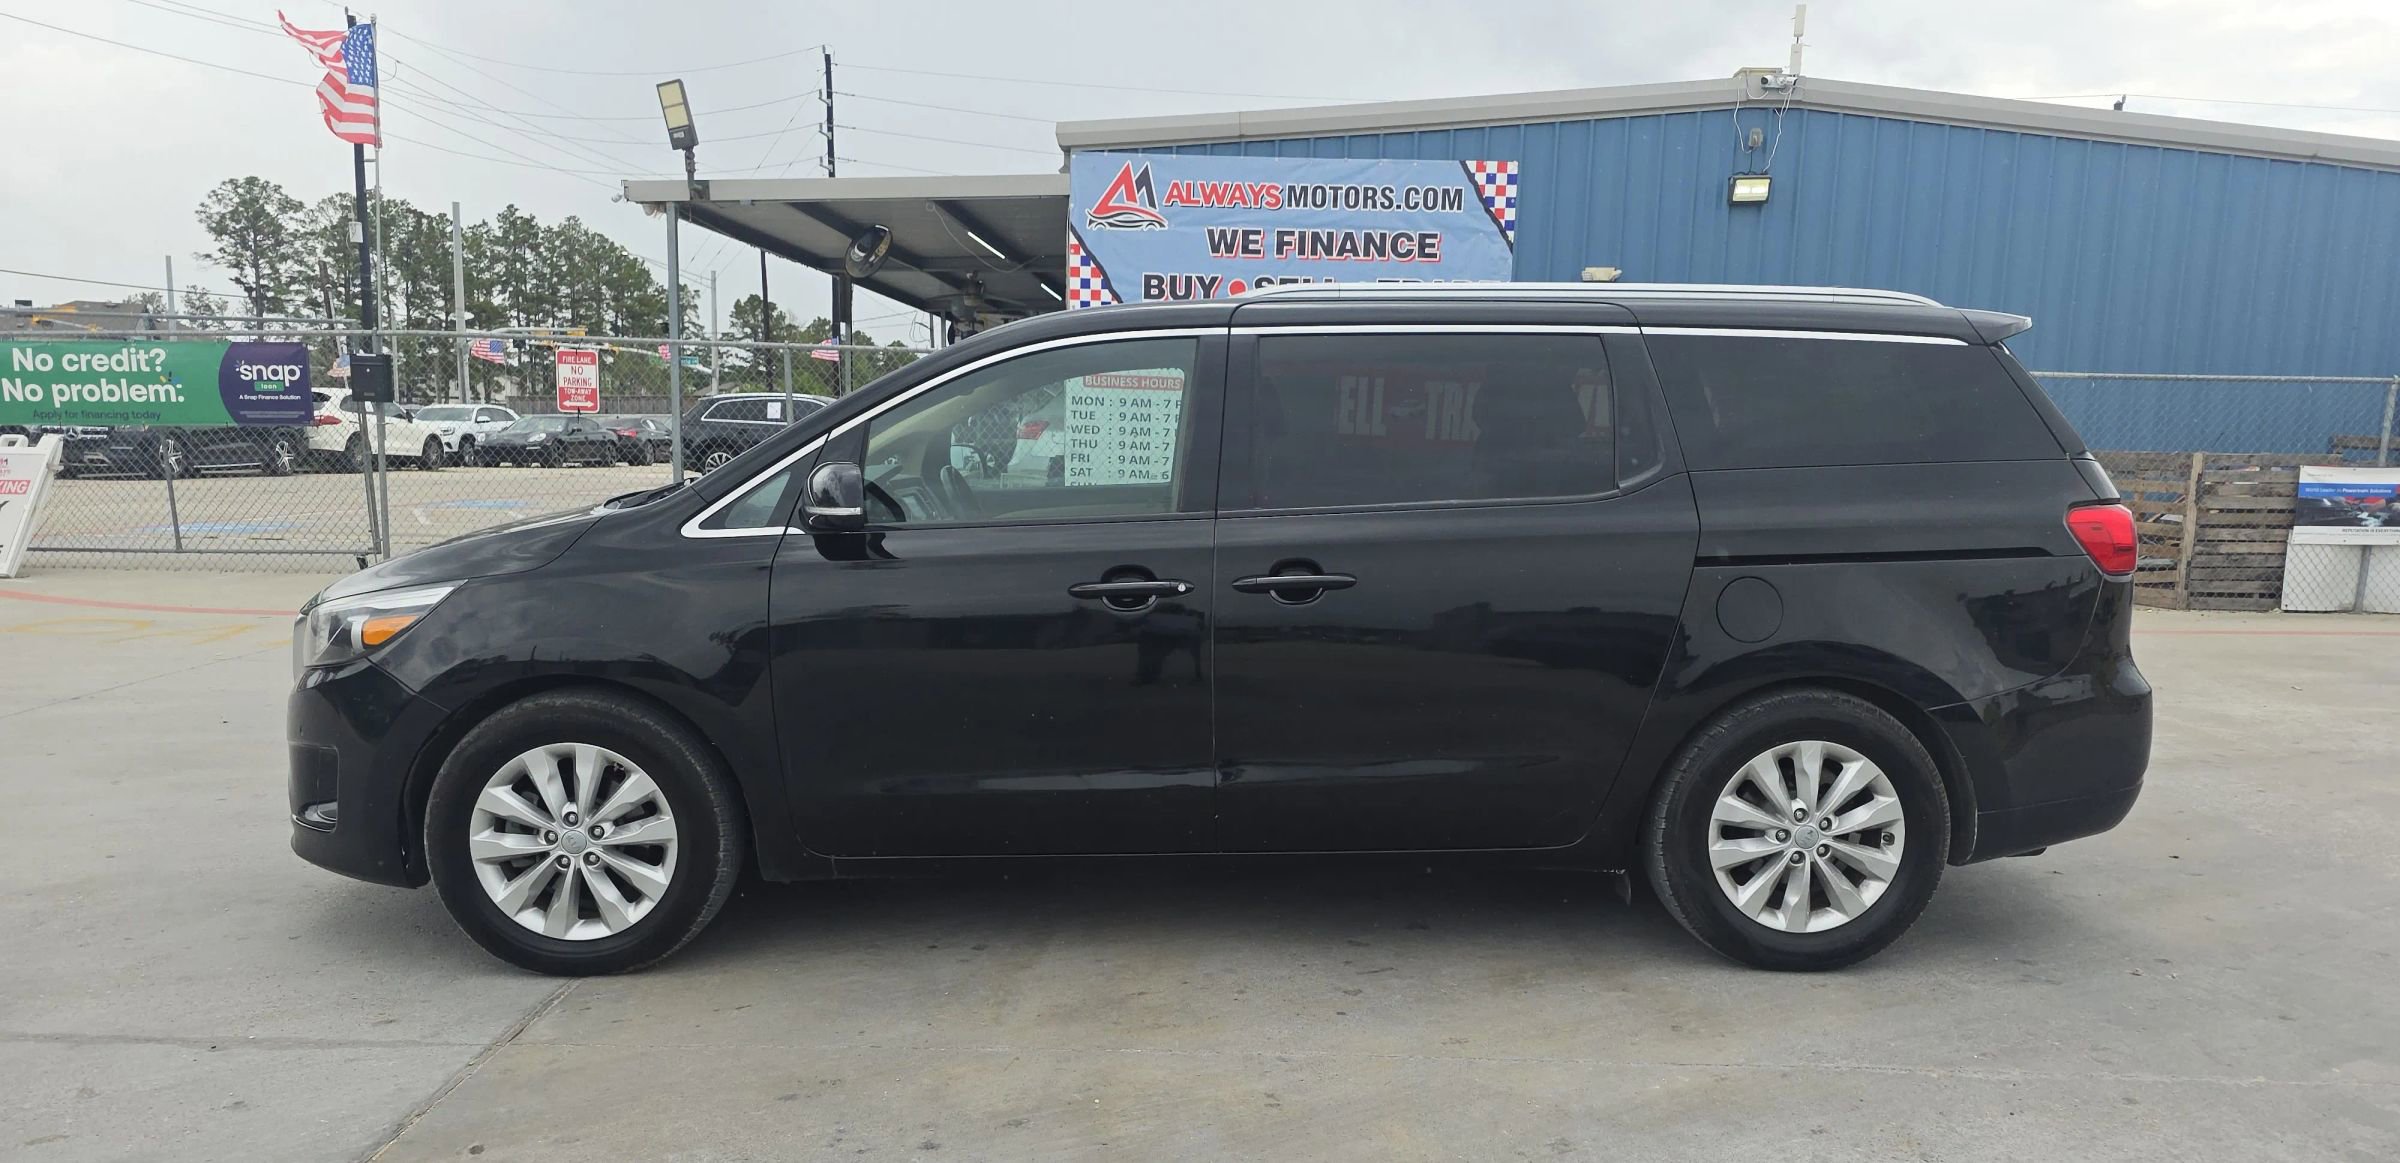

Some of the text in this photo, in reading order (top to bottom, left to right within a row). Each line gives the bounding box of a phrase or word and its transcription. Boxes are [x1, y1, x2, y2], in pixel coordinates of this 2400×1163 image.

[1206, 227, 1442, 263] WE FINANCE
[1143, 273, 1224, 300] BUY
[12, 347, 166, 372] No credit?
[240, 365, 301, 387] snap
[571, 366, 583, 375] NO
[563, 377, 592, 387] PARKING
[1084, 375, 1181, 389] BUSINESS HOURS
[1, 378, 44, 402] No
[1071, 396, 1105, 407] MON
[1119, 398, 1127, 407] 9
[1130, 399, 1152, 409] AM
[1163, 400, 1171, 409] 7
[33, 409, 161, 422] Apply for financing today
[1071, 410, 1096, 420] TUE
[1119, 412, 1127, 421] 9
[1130, 413, 1151, 423] AM
[1163, 414, 1171, 423] 7
[1070, 425, 1100, 435] WED
[1118, 426, 1126, 436] 9
[1129, 427, 1151, 438] AM
[1163, 428, 1170, 437] 7
[1070, 439, 1098, 449] THU
[1118, 440, 1126, 450] 9
[1129, 441, 1151, 451] AM
[1162, 442, 1170, 452] 7
[1070, 453, 1090, 463] FRI
[1118, 455, 1125, 465] 9
[1129, 455, 1150, 466] AM
[1162, 456, 1170, 466] 7
[1070, 467, 1093, 477] SAT
[1118, 469, 1125, 478] 9
[1128, 469, 1150, 480] AM
[1161, 470, 1169, 480] 6
